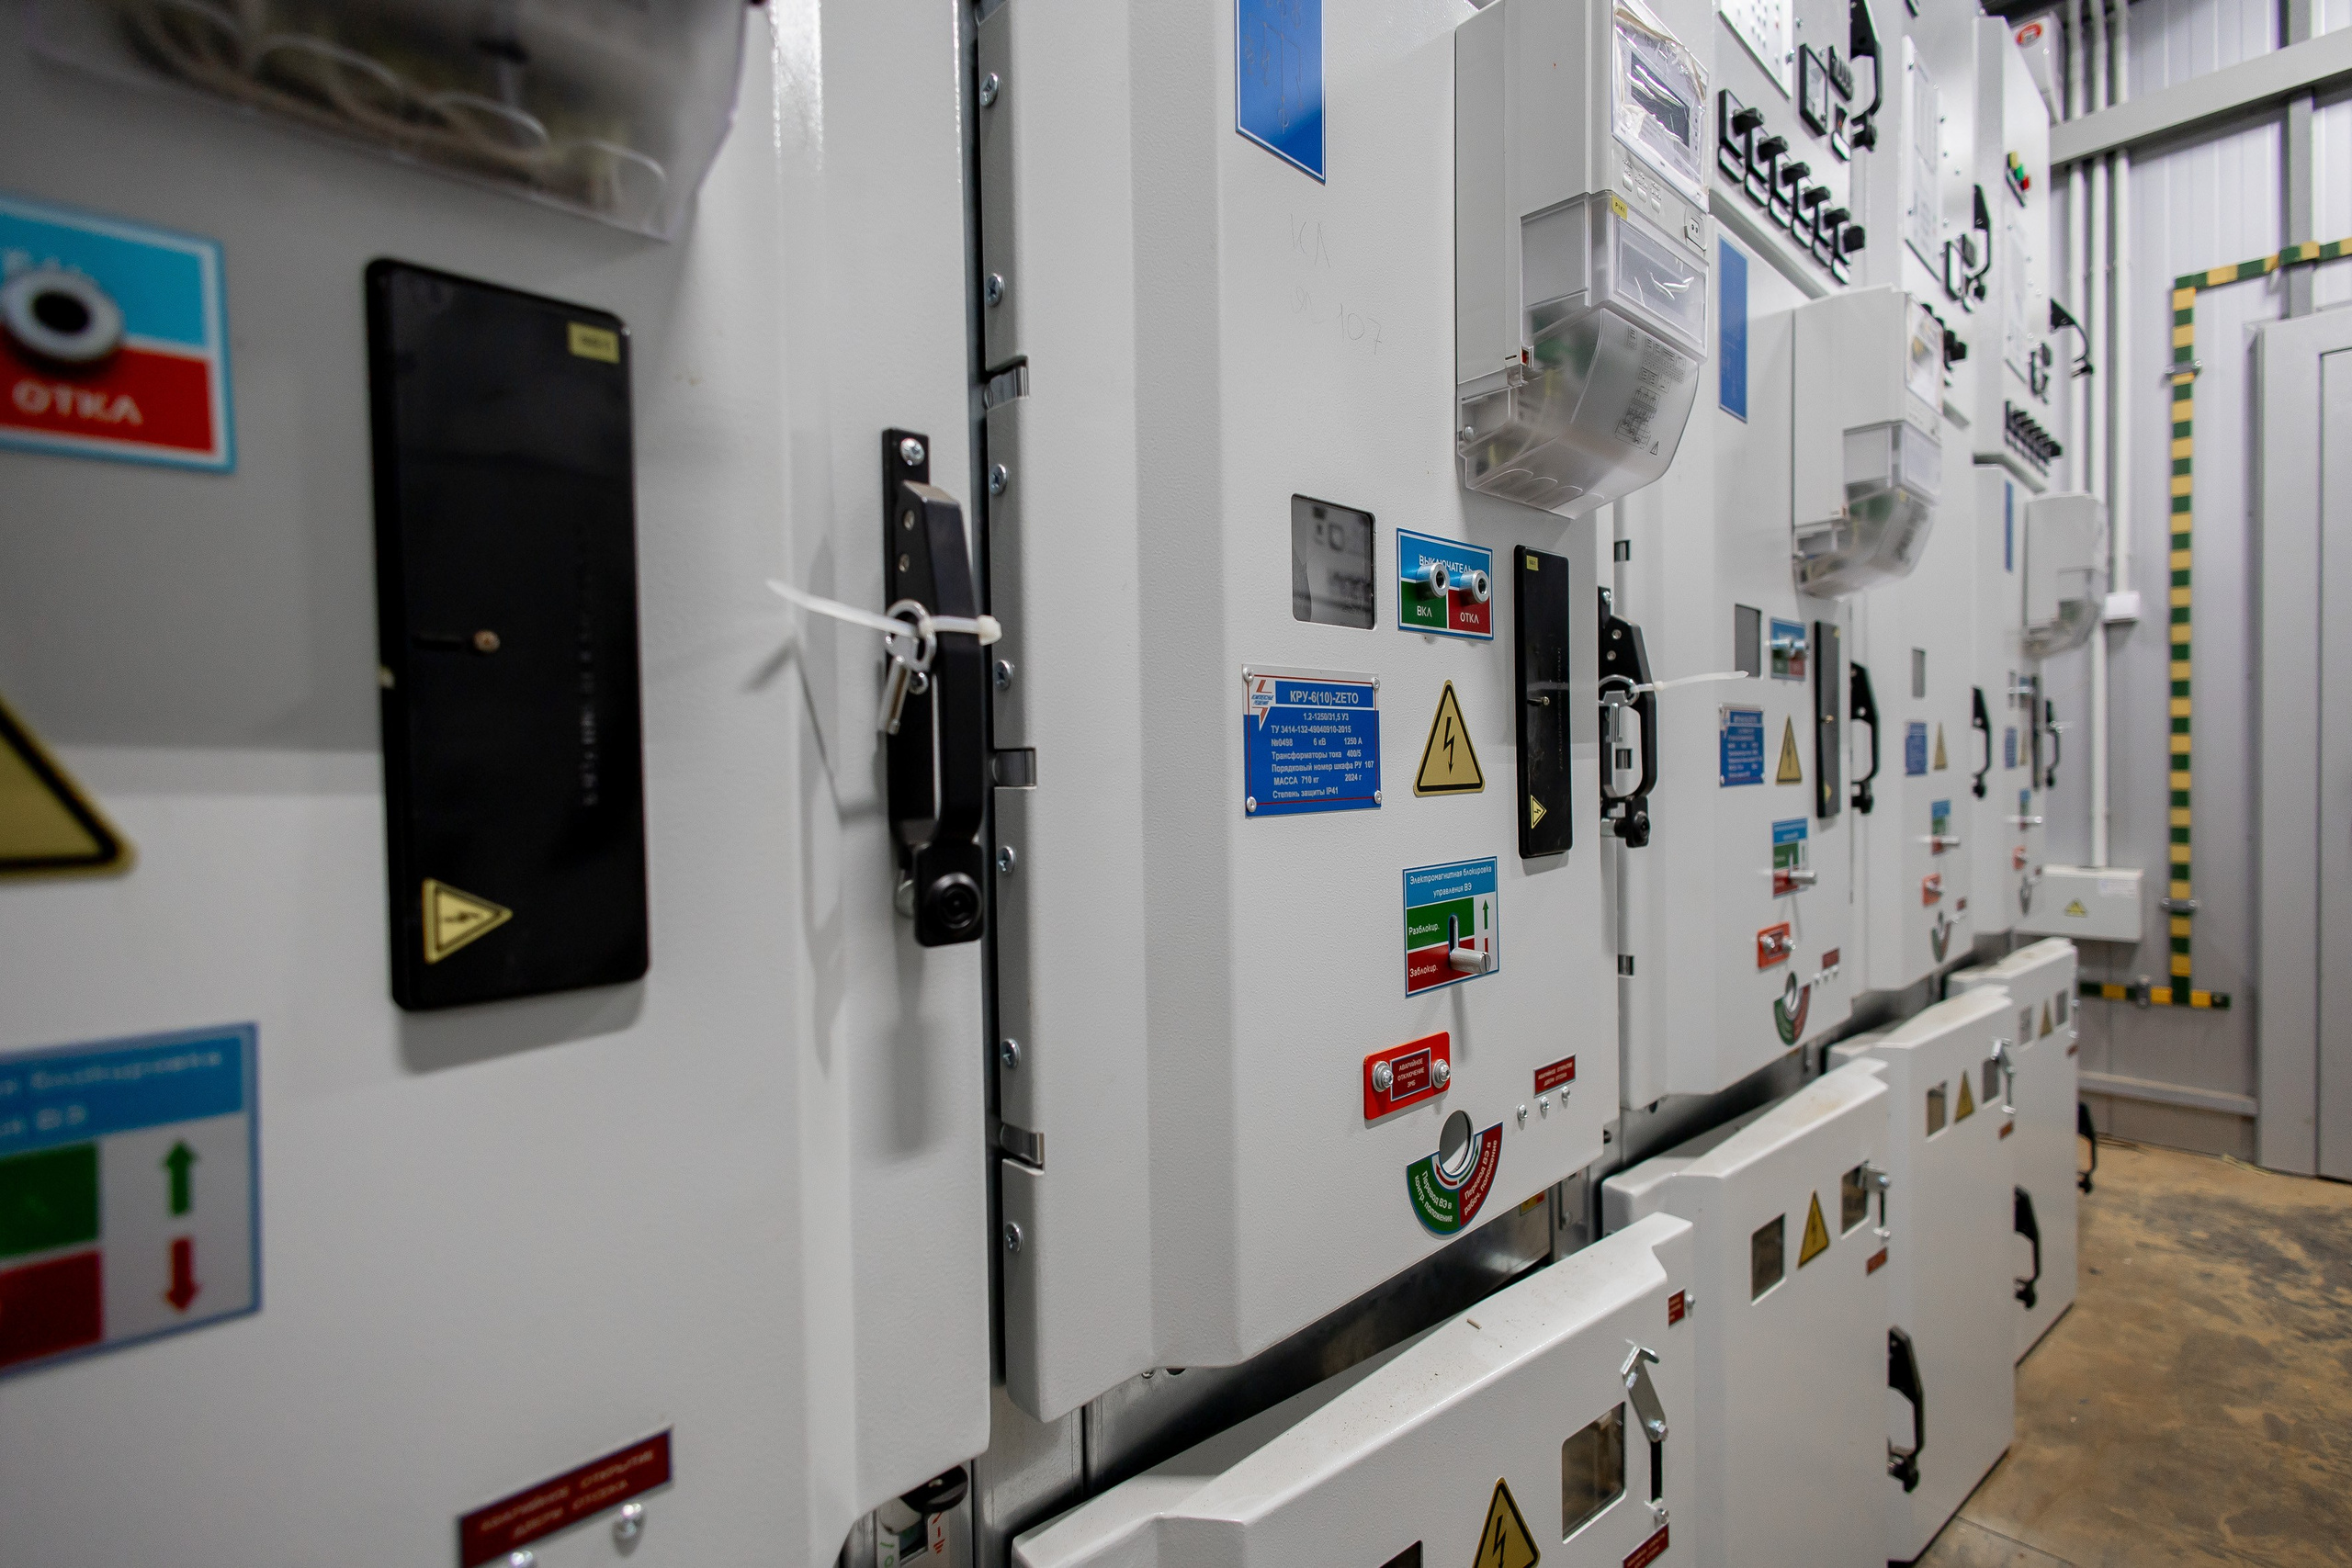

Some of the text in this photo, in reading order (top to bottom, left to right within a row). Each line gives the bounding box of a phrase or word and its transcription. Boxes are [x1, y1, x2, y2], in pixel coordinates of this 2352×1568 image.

[1417, 605, 1432, 617] ВКЛ
[1460, 612, 1479, 624] ОТКЛ
[1290, 690, 1359, 705] КРУ-6(10)-ZETO
[1271, 725, 1279, 734] ТУ
[1313, 737, 1317, 746] 6
[1343, 737, 1357, 745] 1250
[1272, 750, 1328, 761] Трансформаторы
[1272, 762, 1313, 773] Порядковый
[1313, 764, 1333, 773] номер
[1334, 761, 1353, 771] шкафа
[1354, 761, 1363, 769] РУ
[1273, 776, 1298, 785] МАССА
[1301, 775, 1312, 784] 710
[1272, 786, 1339, 799] Степень защиты IP41
[1409, 865, 1492, 885] Электромагнитная блокировка
[1433, 882, 1472, 898] управления ВЭ
[1408, 922, 1440, 936] Разблокир.
[1409, 964, 1439, 977] Заблокир.
